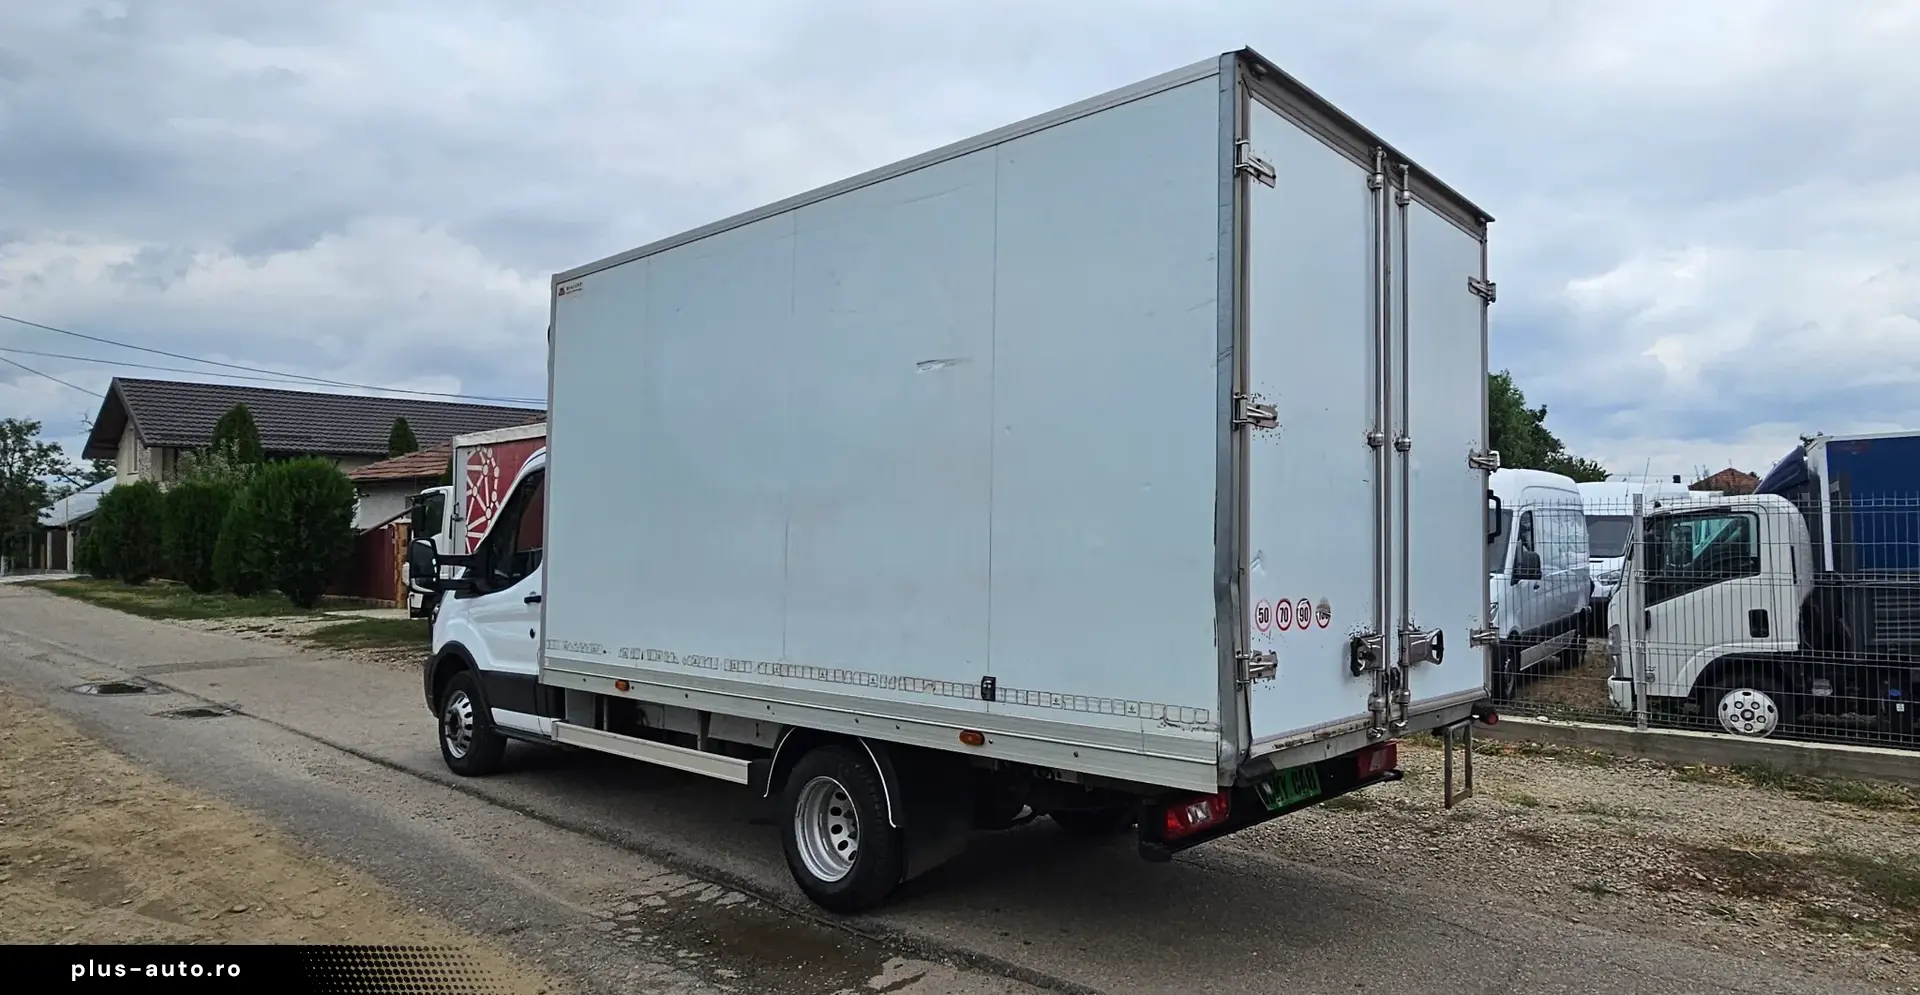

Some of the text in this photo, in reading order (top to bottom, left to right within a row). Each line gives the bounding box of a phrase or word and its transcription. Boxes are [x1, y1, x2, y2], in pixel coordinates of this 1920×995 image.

[1258, 607, 1269, 624] 50
[1280, 606, 1289, 623] 70
[1299, 606, 1309, 623] 90
